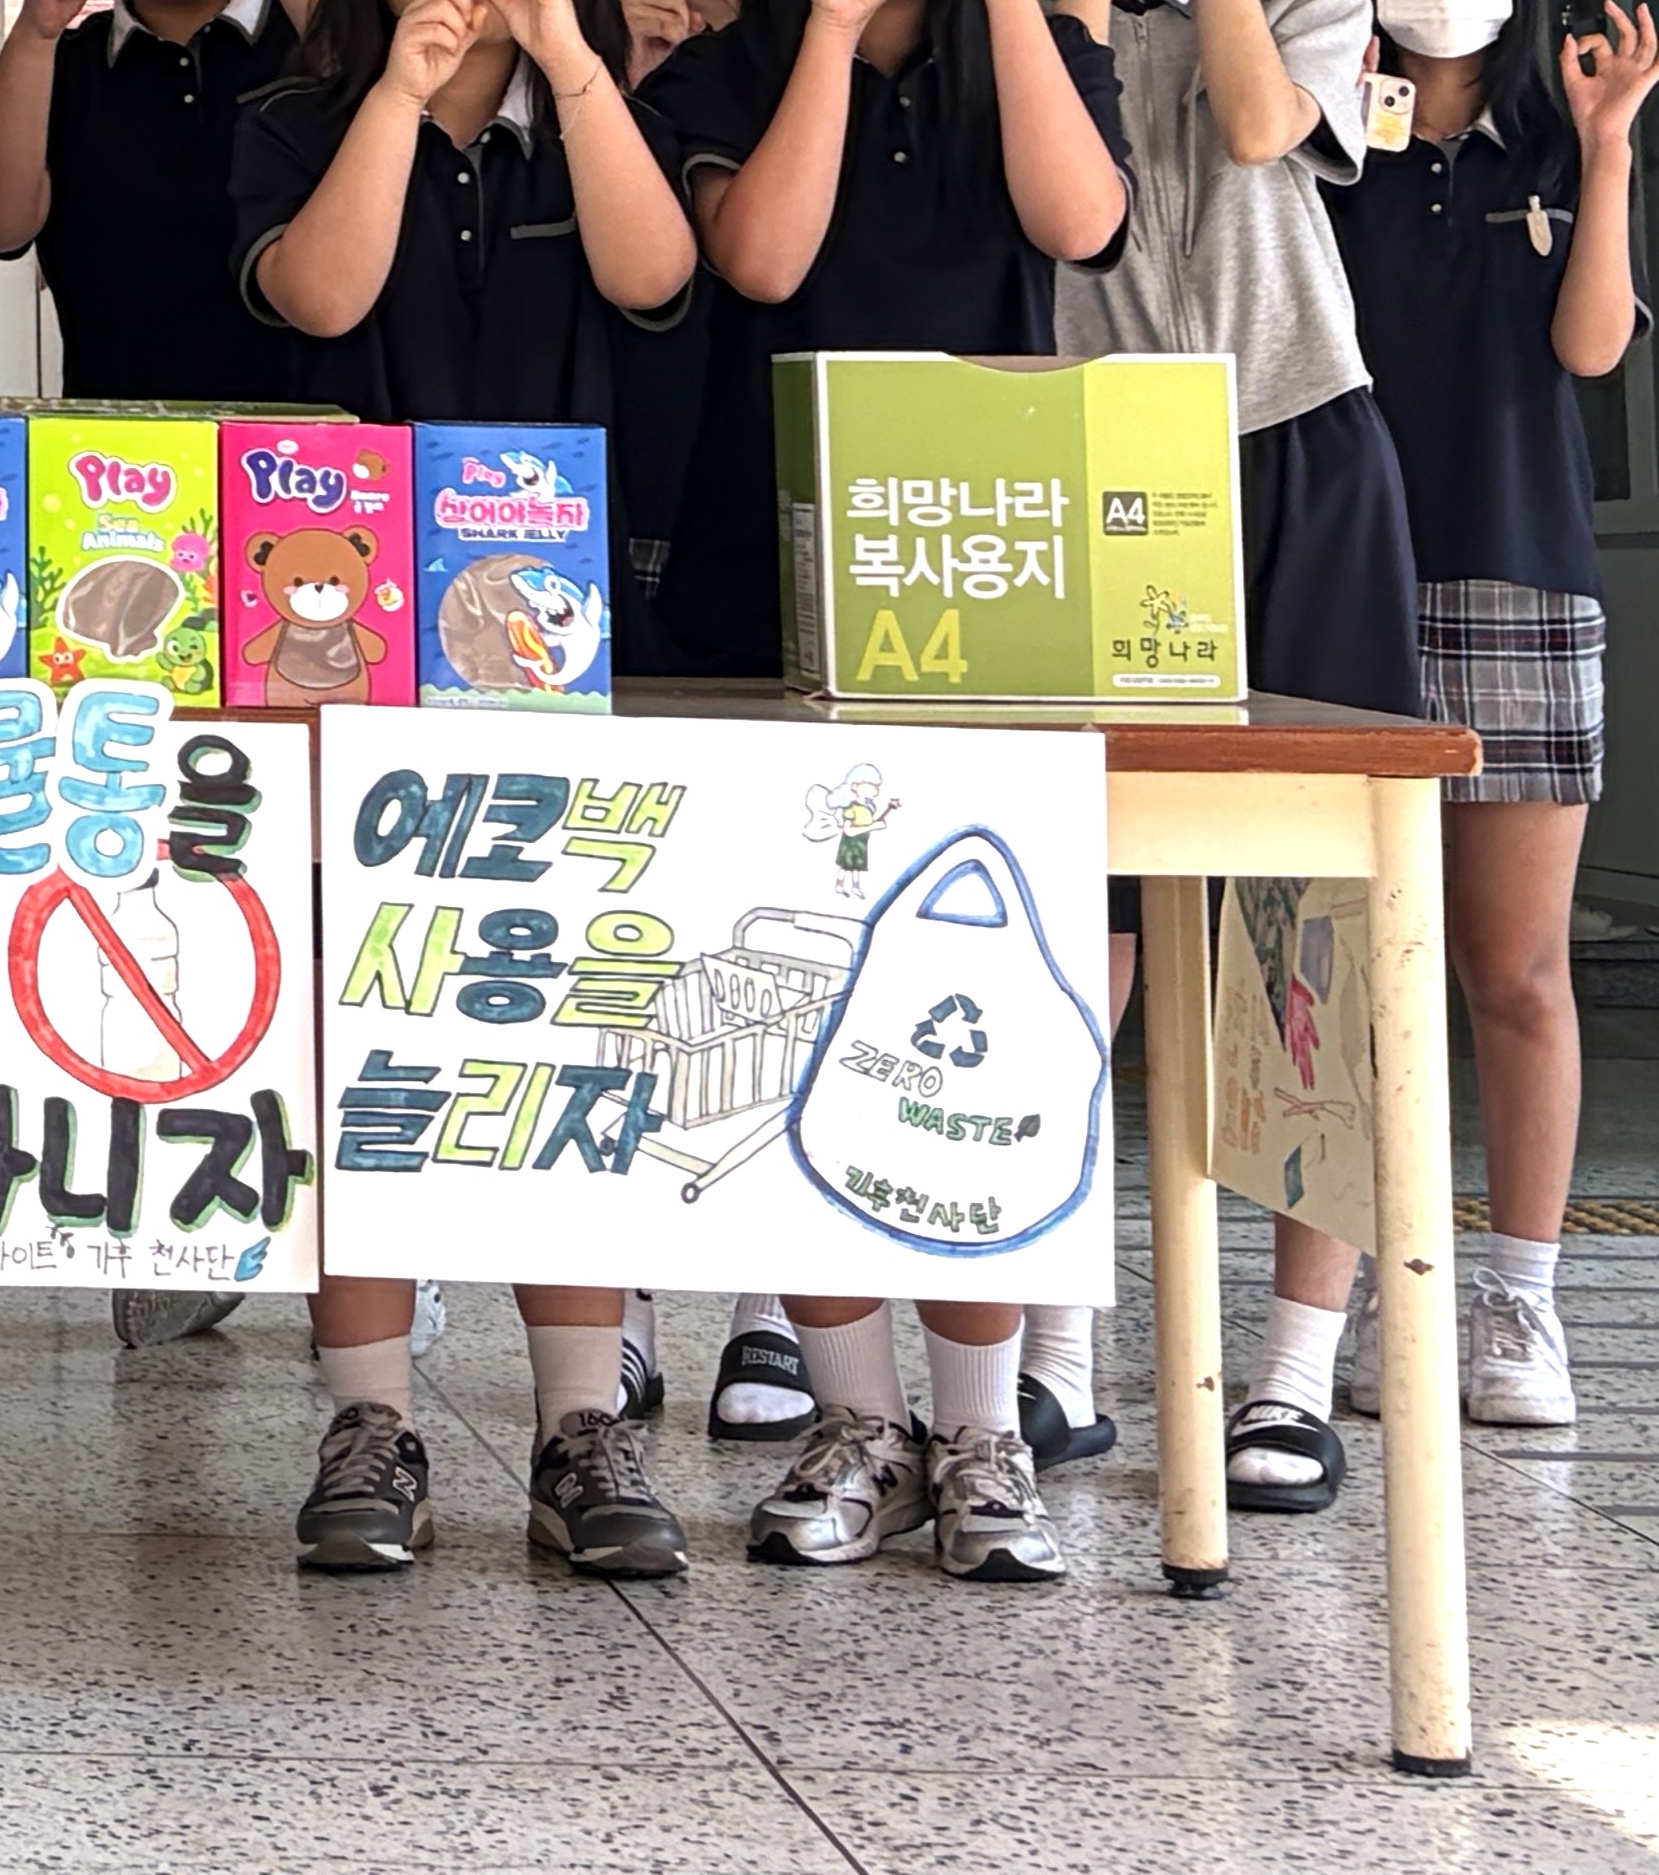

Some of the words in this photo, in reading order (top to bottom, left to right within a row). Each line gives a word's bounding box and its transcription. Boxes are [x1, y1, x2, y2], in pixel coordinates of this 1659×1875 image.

[73, 453, 173, 508] Play
[245, 450, 345, 509] Play
[846, 476, 1070, 528] 희망나라
[460, 527, 518, 539] SHARK
[1105, 496, 1146, 525] A4
[81, 532, 165, 552] Animals
[848, 533, 1066, 600] 복사용지
[856, 608, 969, 684] A4
[353, 768, 687, 893] 에코백
[338, 901, 684, 1028] 사용을
[840, 1039, 944, 1096] ZERO
[335, 1049, 664, 1176] 늘리자
[897, 1096, 1015, 1146] WASTE
[149, 1239, 235, 1281] 천사단
[742, 1345, 800, 1376] RESTART
